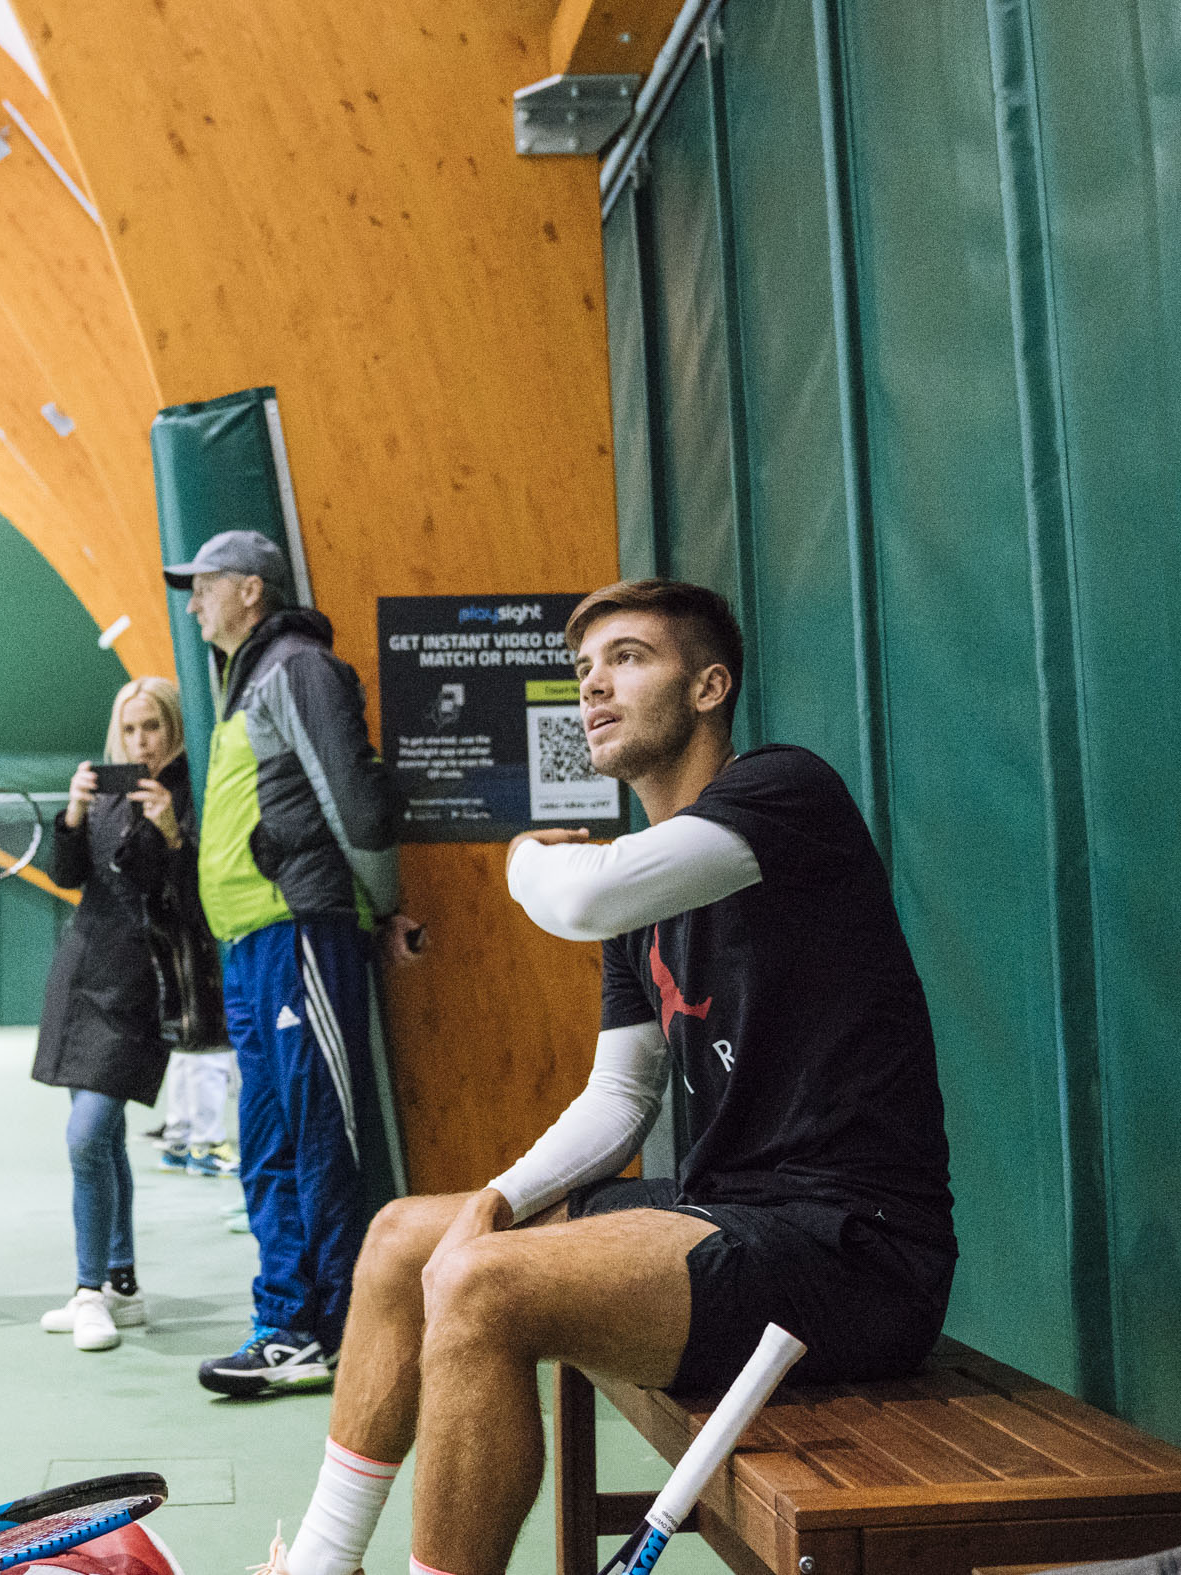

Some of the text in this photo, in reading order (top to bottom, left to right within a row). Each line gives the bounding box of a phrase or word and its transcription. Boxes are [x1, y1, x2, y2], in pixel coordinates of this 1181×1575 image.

[389, 632, 566, 651] GET INSTANT VIDEO OF
[419, 651, 476, 667] MATCH
[478, 650, 502, 666] OR
